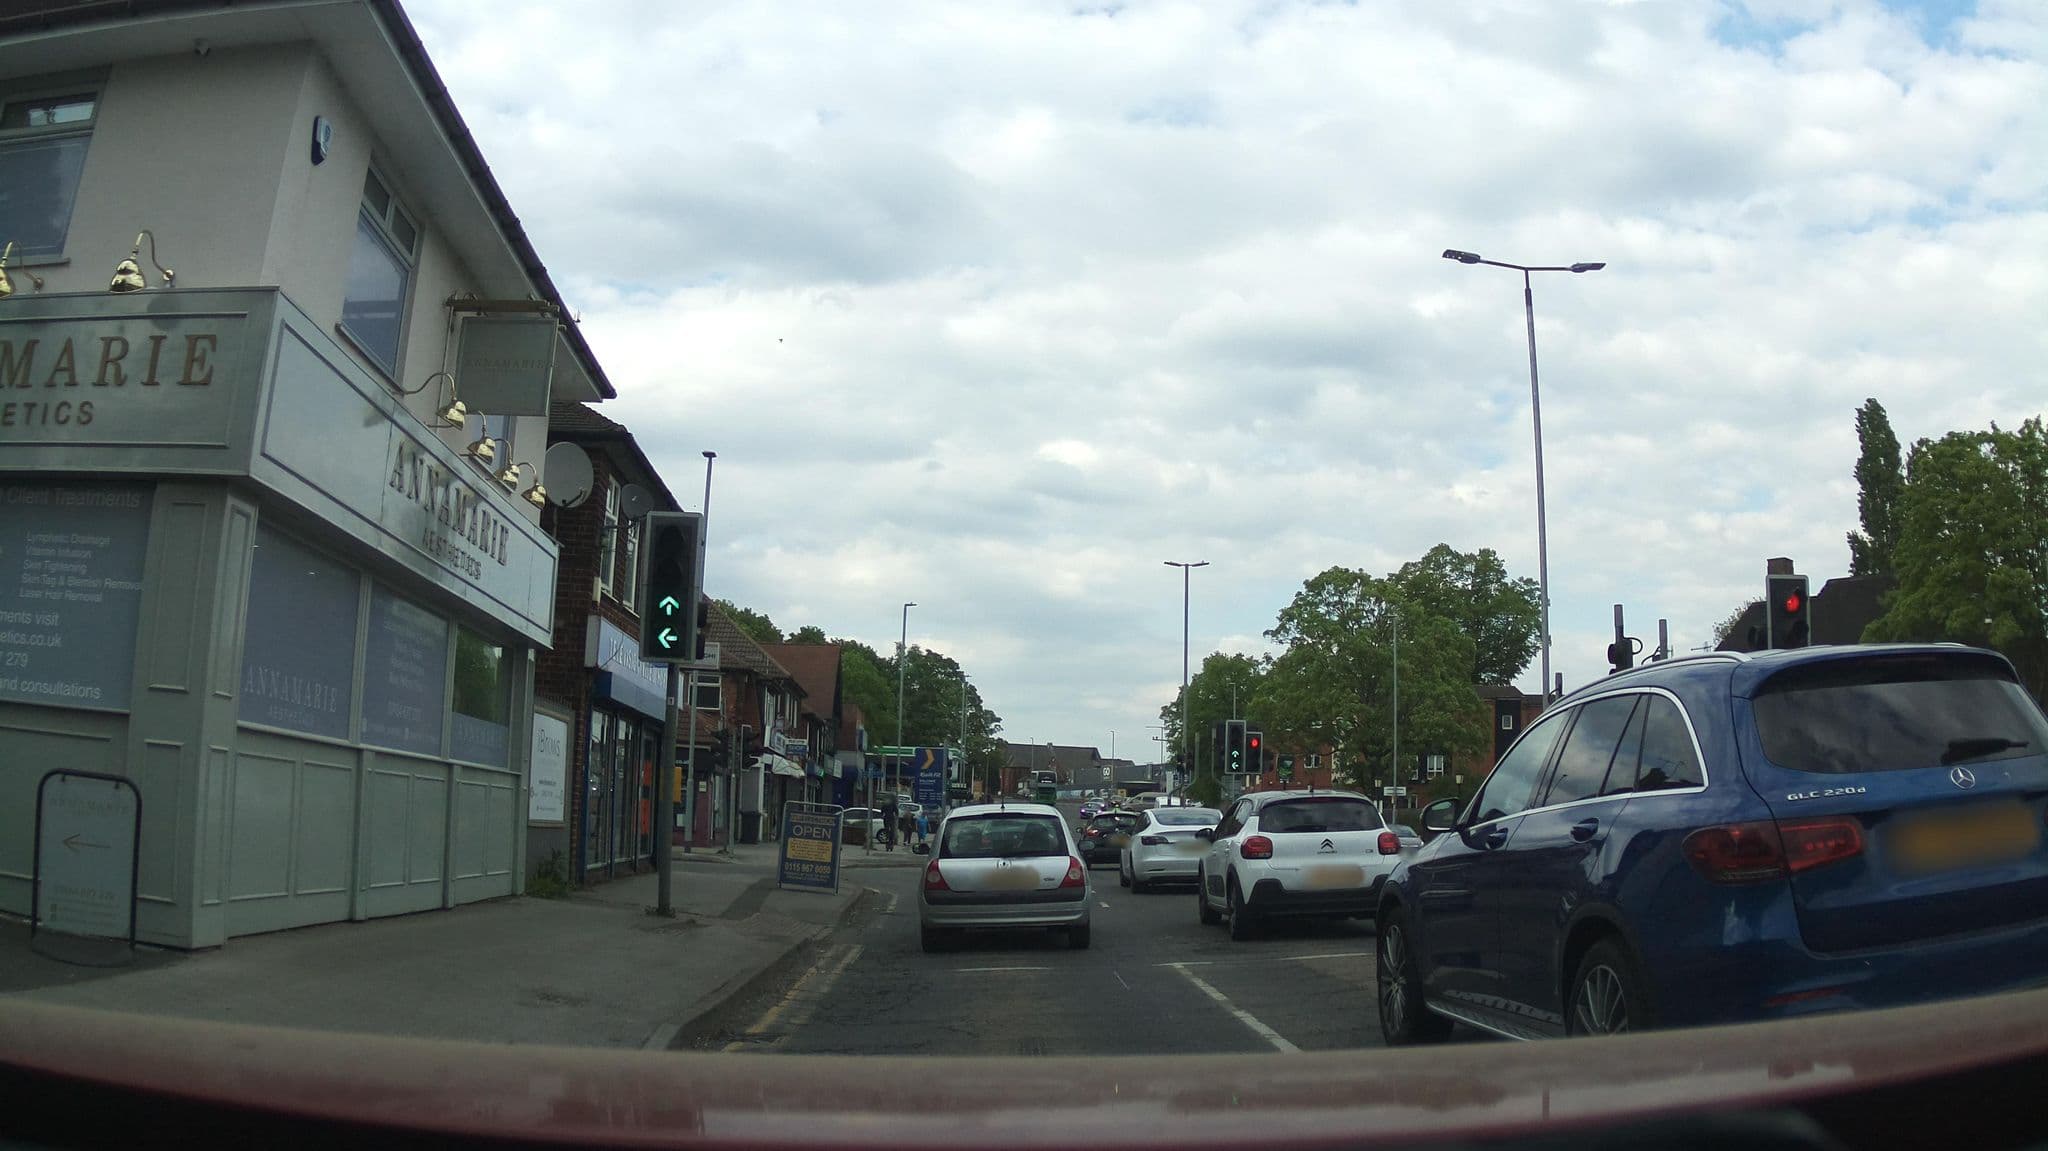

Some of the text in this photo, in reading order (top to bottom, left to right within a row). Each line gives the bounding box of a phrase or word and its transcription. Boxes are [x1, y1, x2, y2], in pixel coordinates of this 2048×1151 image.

[2, 401, 95, 426] ETICS
[1786, 790, 1820, 801] GLC
[792, 824, 832, 840] OPEN
